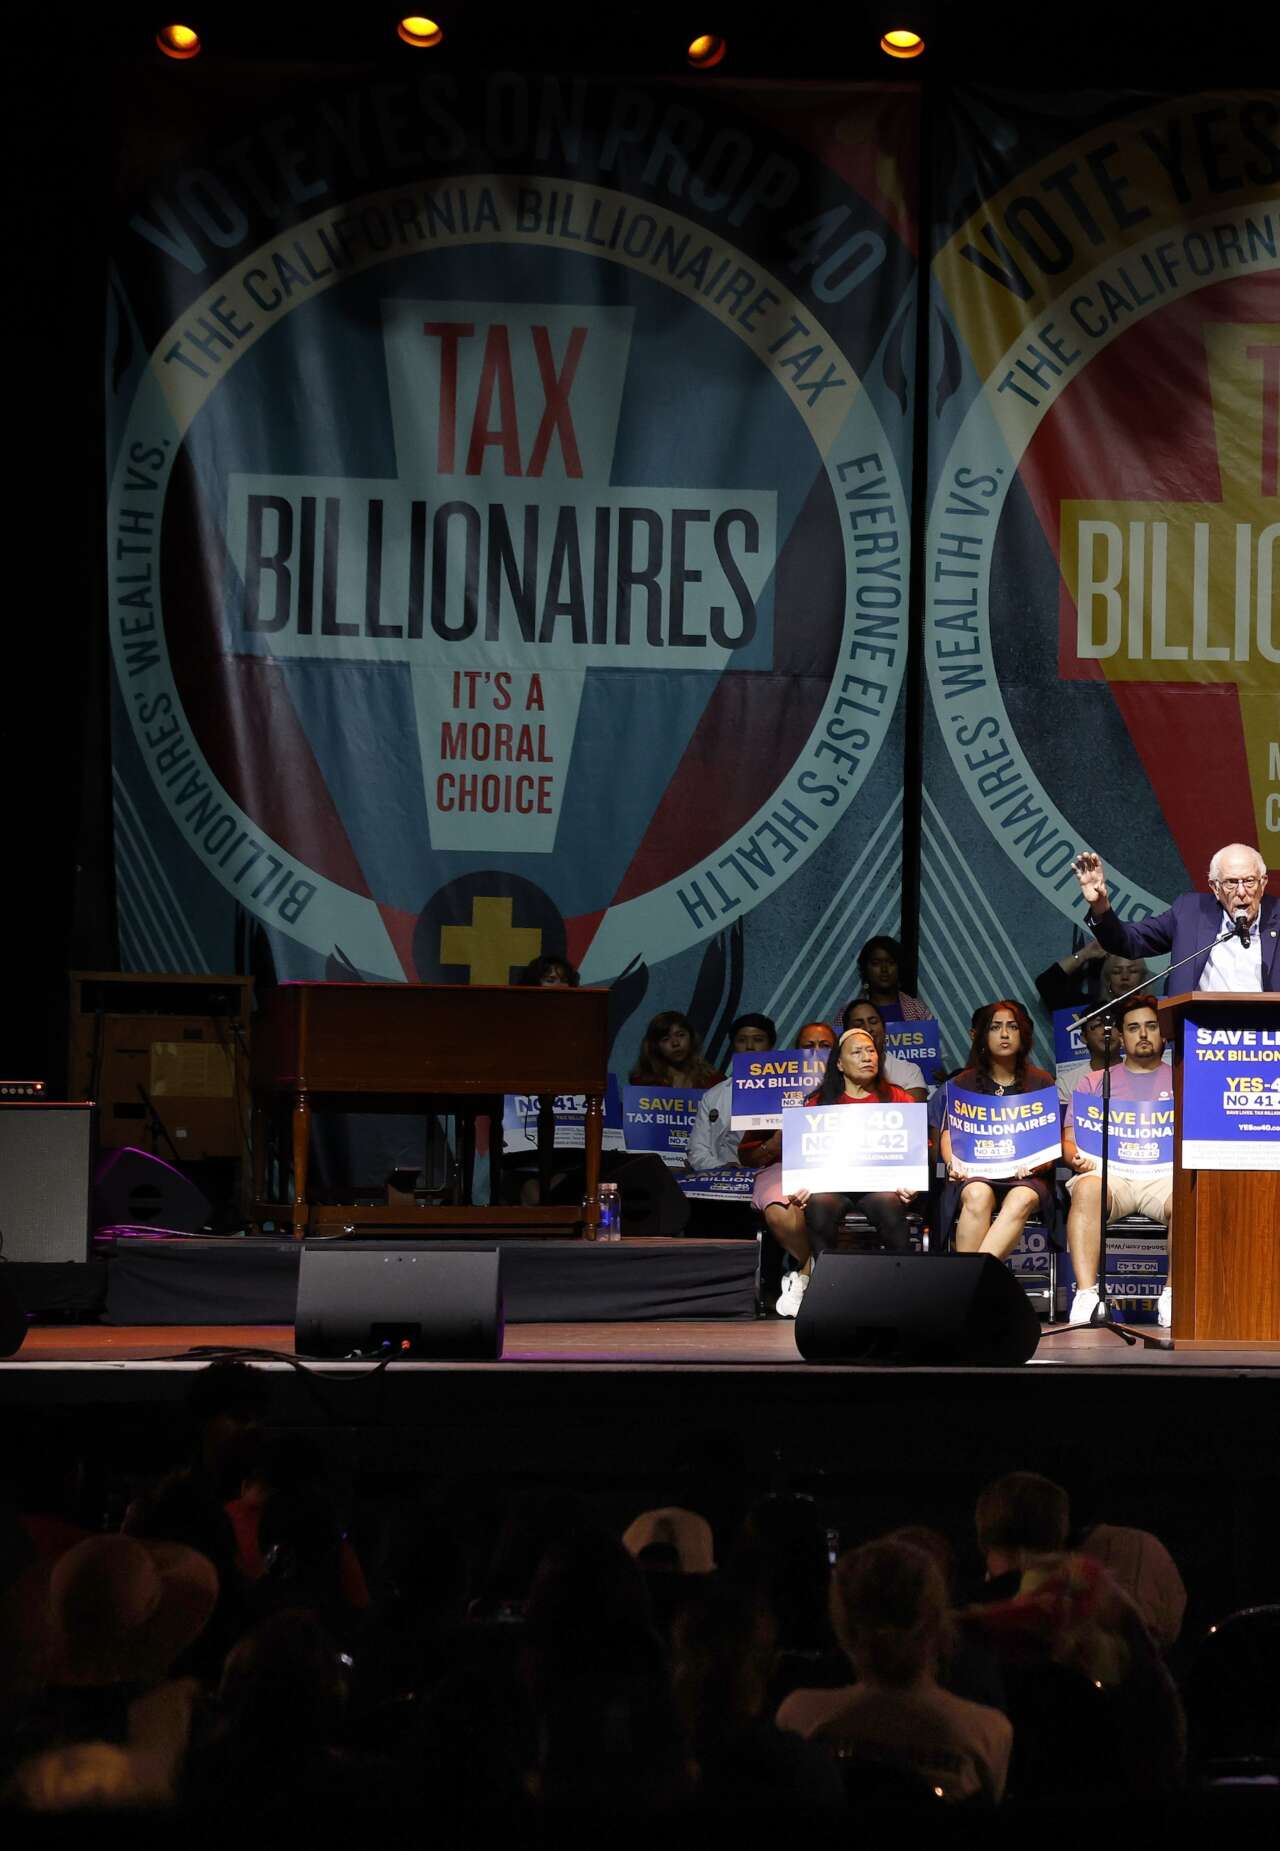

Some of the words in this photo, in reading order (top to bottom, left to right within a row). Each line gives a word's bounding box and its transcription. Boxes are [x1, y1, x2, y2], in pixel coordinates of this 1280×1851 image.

[128, 117, 329, 274] VOTE
[322, 73, 466, 183] YES
[483, 70, 589, 168] ON
[600, 90, 800, 228] PROP
[792, 201, 886, 304] 40
[960, 142, 1152, 303] VOTE
[165, 295, 253, 379] THE
[248, 188, 500, 307] CALIFORNIA
[517, 190, 776, 325] BILLIONAIRE
[767, 314, 846, 406] TAX
[997, 323, 1081, 409] THE
[423, 322, 589, 479] TAX
[124, 436, 169, 493] VS.
[948, 463, 1004, 517] VS.
[245, 495, 760, 649] BILLIONAIRES
[836, 453, 901, 668] EVERYONE
[117, 509, 157, 671] WEALTH
[932, 533, 984, 701] WEALTH
[452, 671, 512, 712] IT'S
[526, 673, 545, 712] A
[441, 723, 553, 763] MORAL
[812, 676, 888, 806] ELSE'S
[436, 773, 553, 815] CHOICE
[677, 799, 823, 930] HEALTH
[1196, 1050, 1224, 1061] TAX
[1197, 1028, 1256, 1045] SAVE
[736, 1078, 765, 1089] TAX
[750, 1061, 798, 1076] SAVE
[627, 1112, 653, 1123] TAX
[639, 1097, 689, 1112] SAVE
[949, 1114, 963, 1130] TAX
[964, 1112, 1056, 1136] BILLIONAIRES
[954, 1100, 986, 1120] SAVE
[991, 1102, 1044, 1121] LIVES
